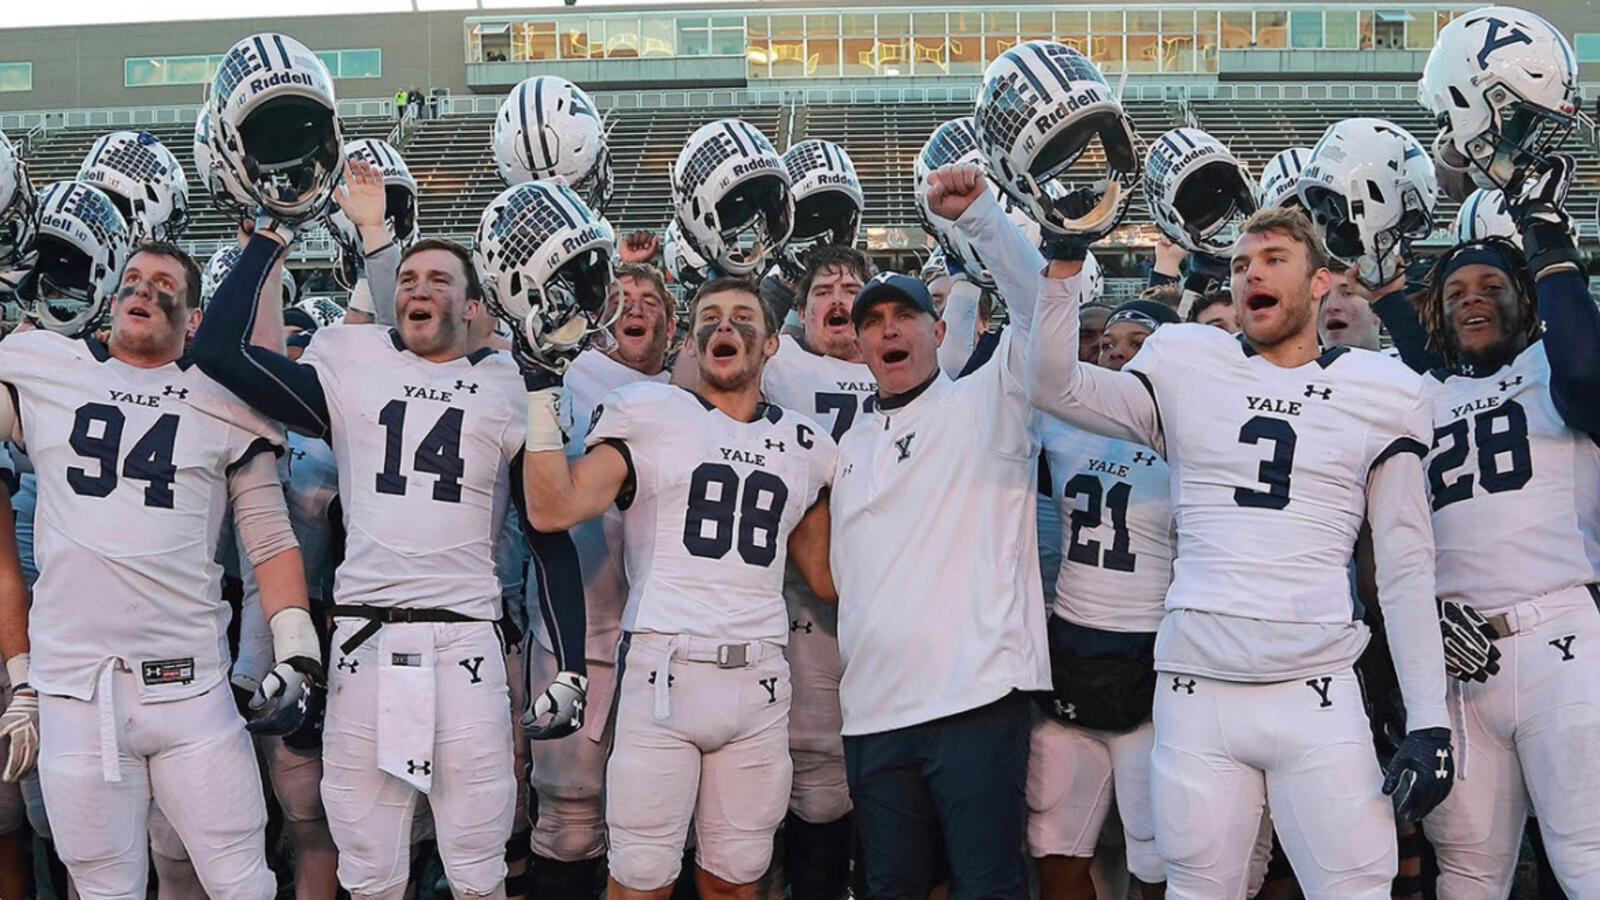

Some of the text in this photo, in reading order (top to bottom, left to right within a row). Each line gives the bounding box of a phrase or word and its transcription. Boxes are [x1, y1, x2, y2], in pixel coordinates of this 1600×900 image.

[1477, 17, 1533, 71] Y
[250, 72, 313, 94] Riddell
[1035, 89, 1101, 134] Riddell
[1023, 135, 1036, 154] 147
[733, 158, 780, 176] Riddell
[1171, 146, 1215, 175] Riddell
[547, 252, 560, 269] 147
[109, 390, 161, 408] YALE
[403, 385, 453, 402] YALE
[836, 381, 878, 392] YALE
[815, 391, 878, 446] 7
[1246, 395, 1303, 416] YALE
[1452, 396, 1500, 418] YALE
[796, 423, 815, 450] C
[894, 431, 917, 463] Y
[67, 402, 181, 509] 94
[376, 399, 465, 503] 14
[720, 447, 767, 467] YALE
[1233, 415, 1298, 510] 3
[1428, 398, 1533, 512] 28
[1088, 458, 1130, 478] YALE
[683, 462, 789, 568] 88
[1064, 473, 1137, 573] 21
[1548, 635, 1576, 661] Y
[459, 657, 485, 684] Y
[759, 677, 778, 703] Y
[1305, 677, 1333, 708] Y
